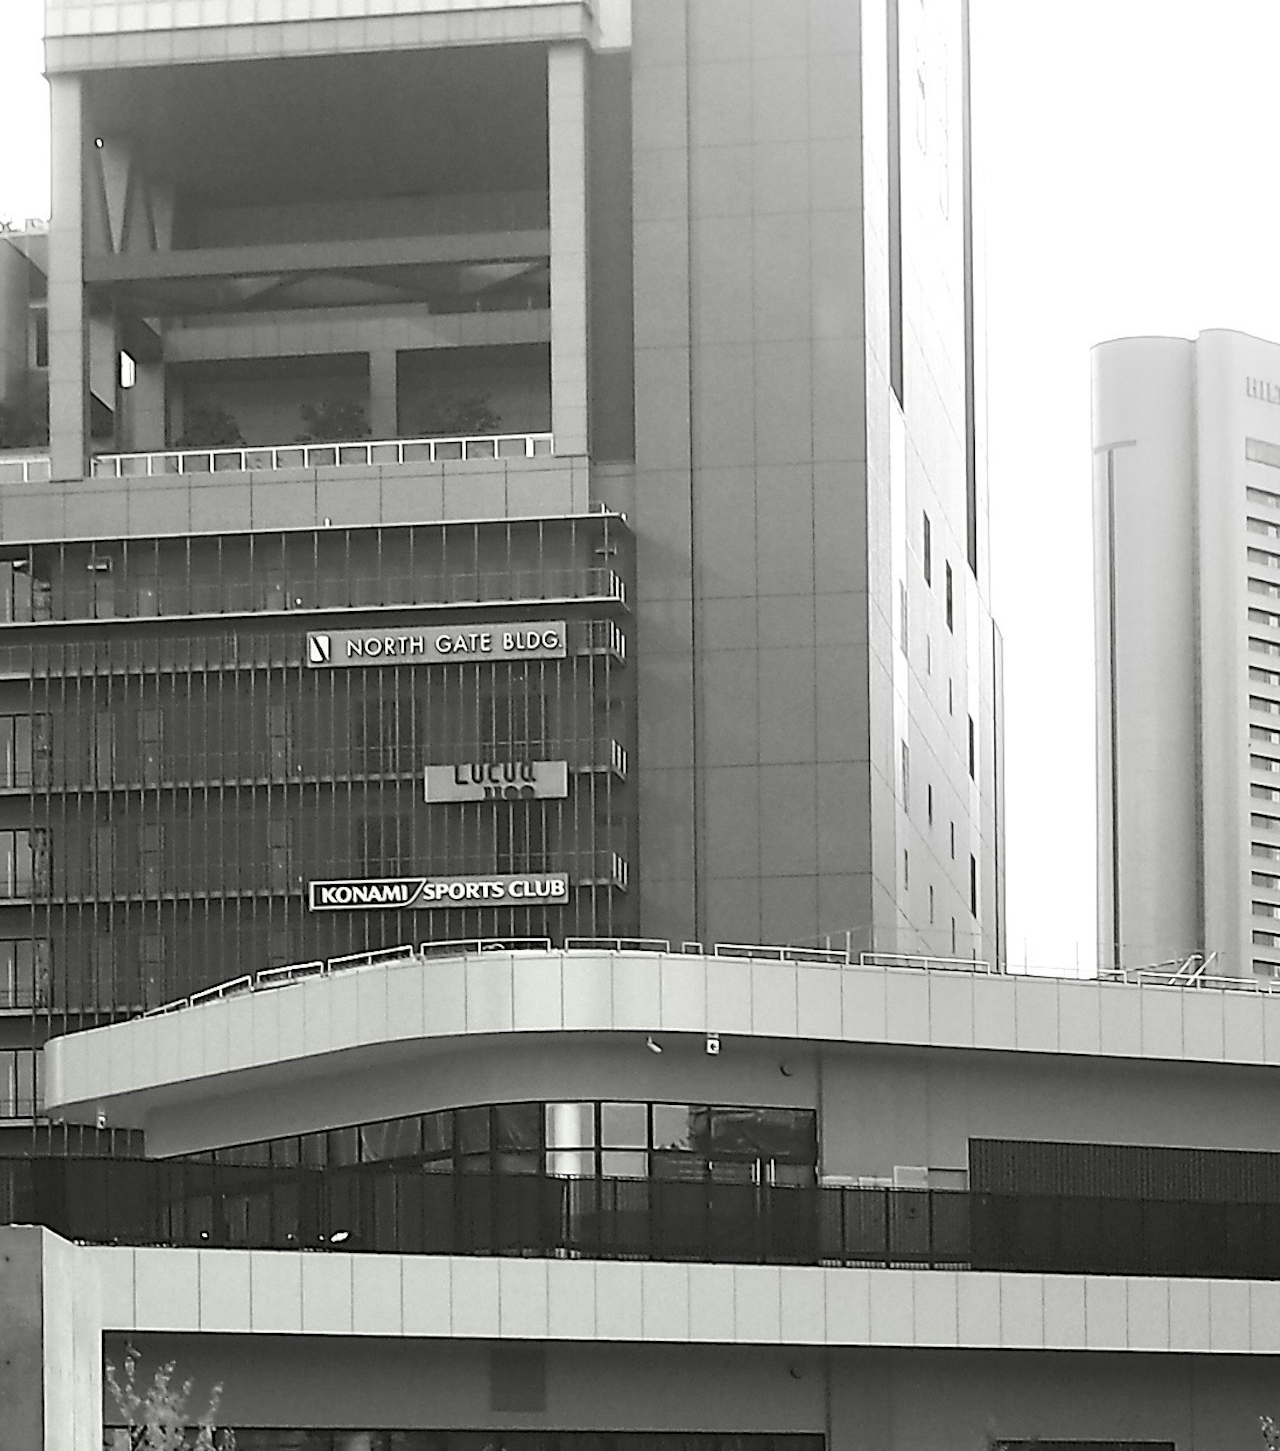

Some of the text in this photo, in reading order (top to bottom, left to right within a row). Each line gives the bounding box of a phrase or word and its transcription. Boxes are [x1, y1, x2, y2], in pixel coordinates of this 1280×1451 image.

[347, 629, 563, 657] NORTH GATE BLDG.
[321, 878, 565, 904] KONAMI SPORTS CLUB
